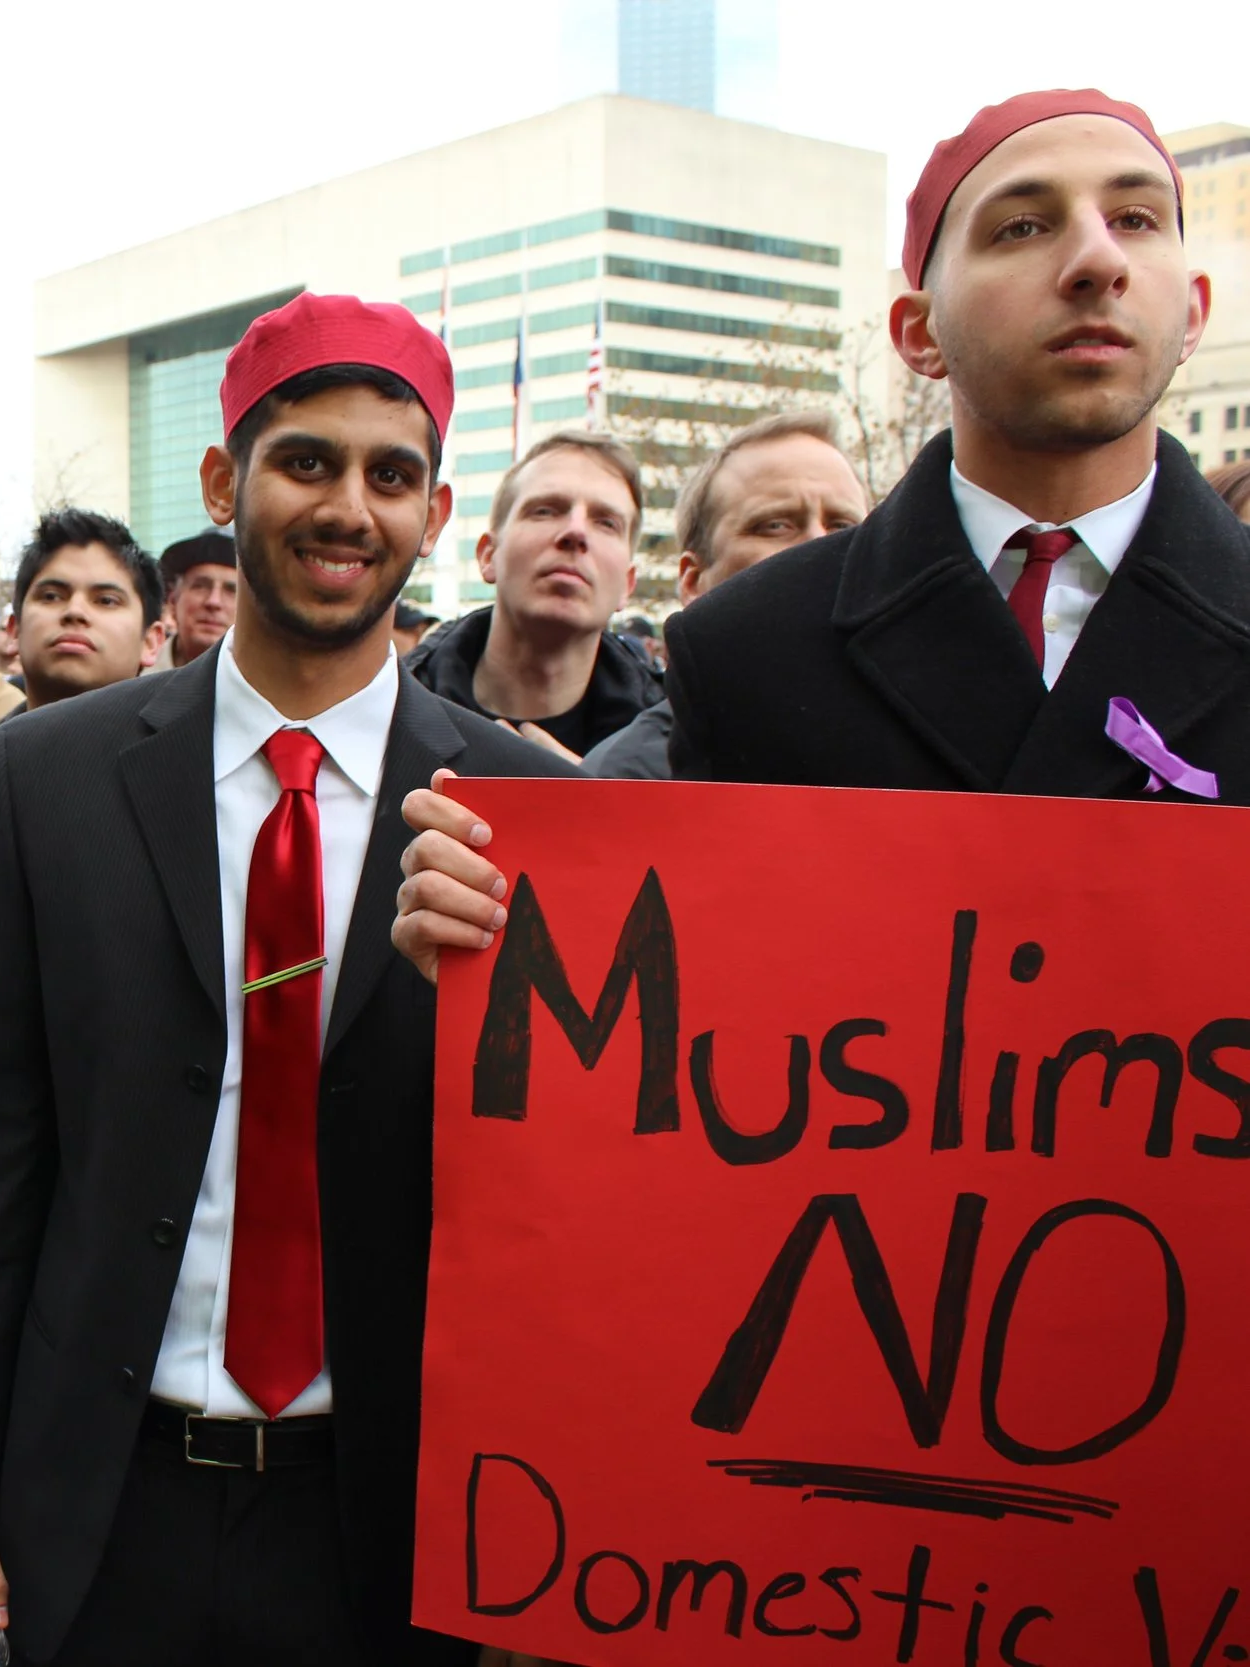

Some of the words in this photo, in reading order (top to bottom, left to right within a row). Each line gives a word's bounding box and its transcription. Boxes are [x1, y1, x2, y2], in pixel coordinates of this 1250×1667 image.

[472, 866, 1250, 1165] Muslims
[691, 1192, 1186, 1465] NO
[466, 1453, 1054, 1667] Domestic
